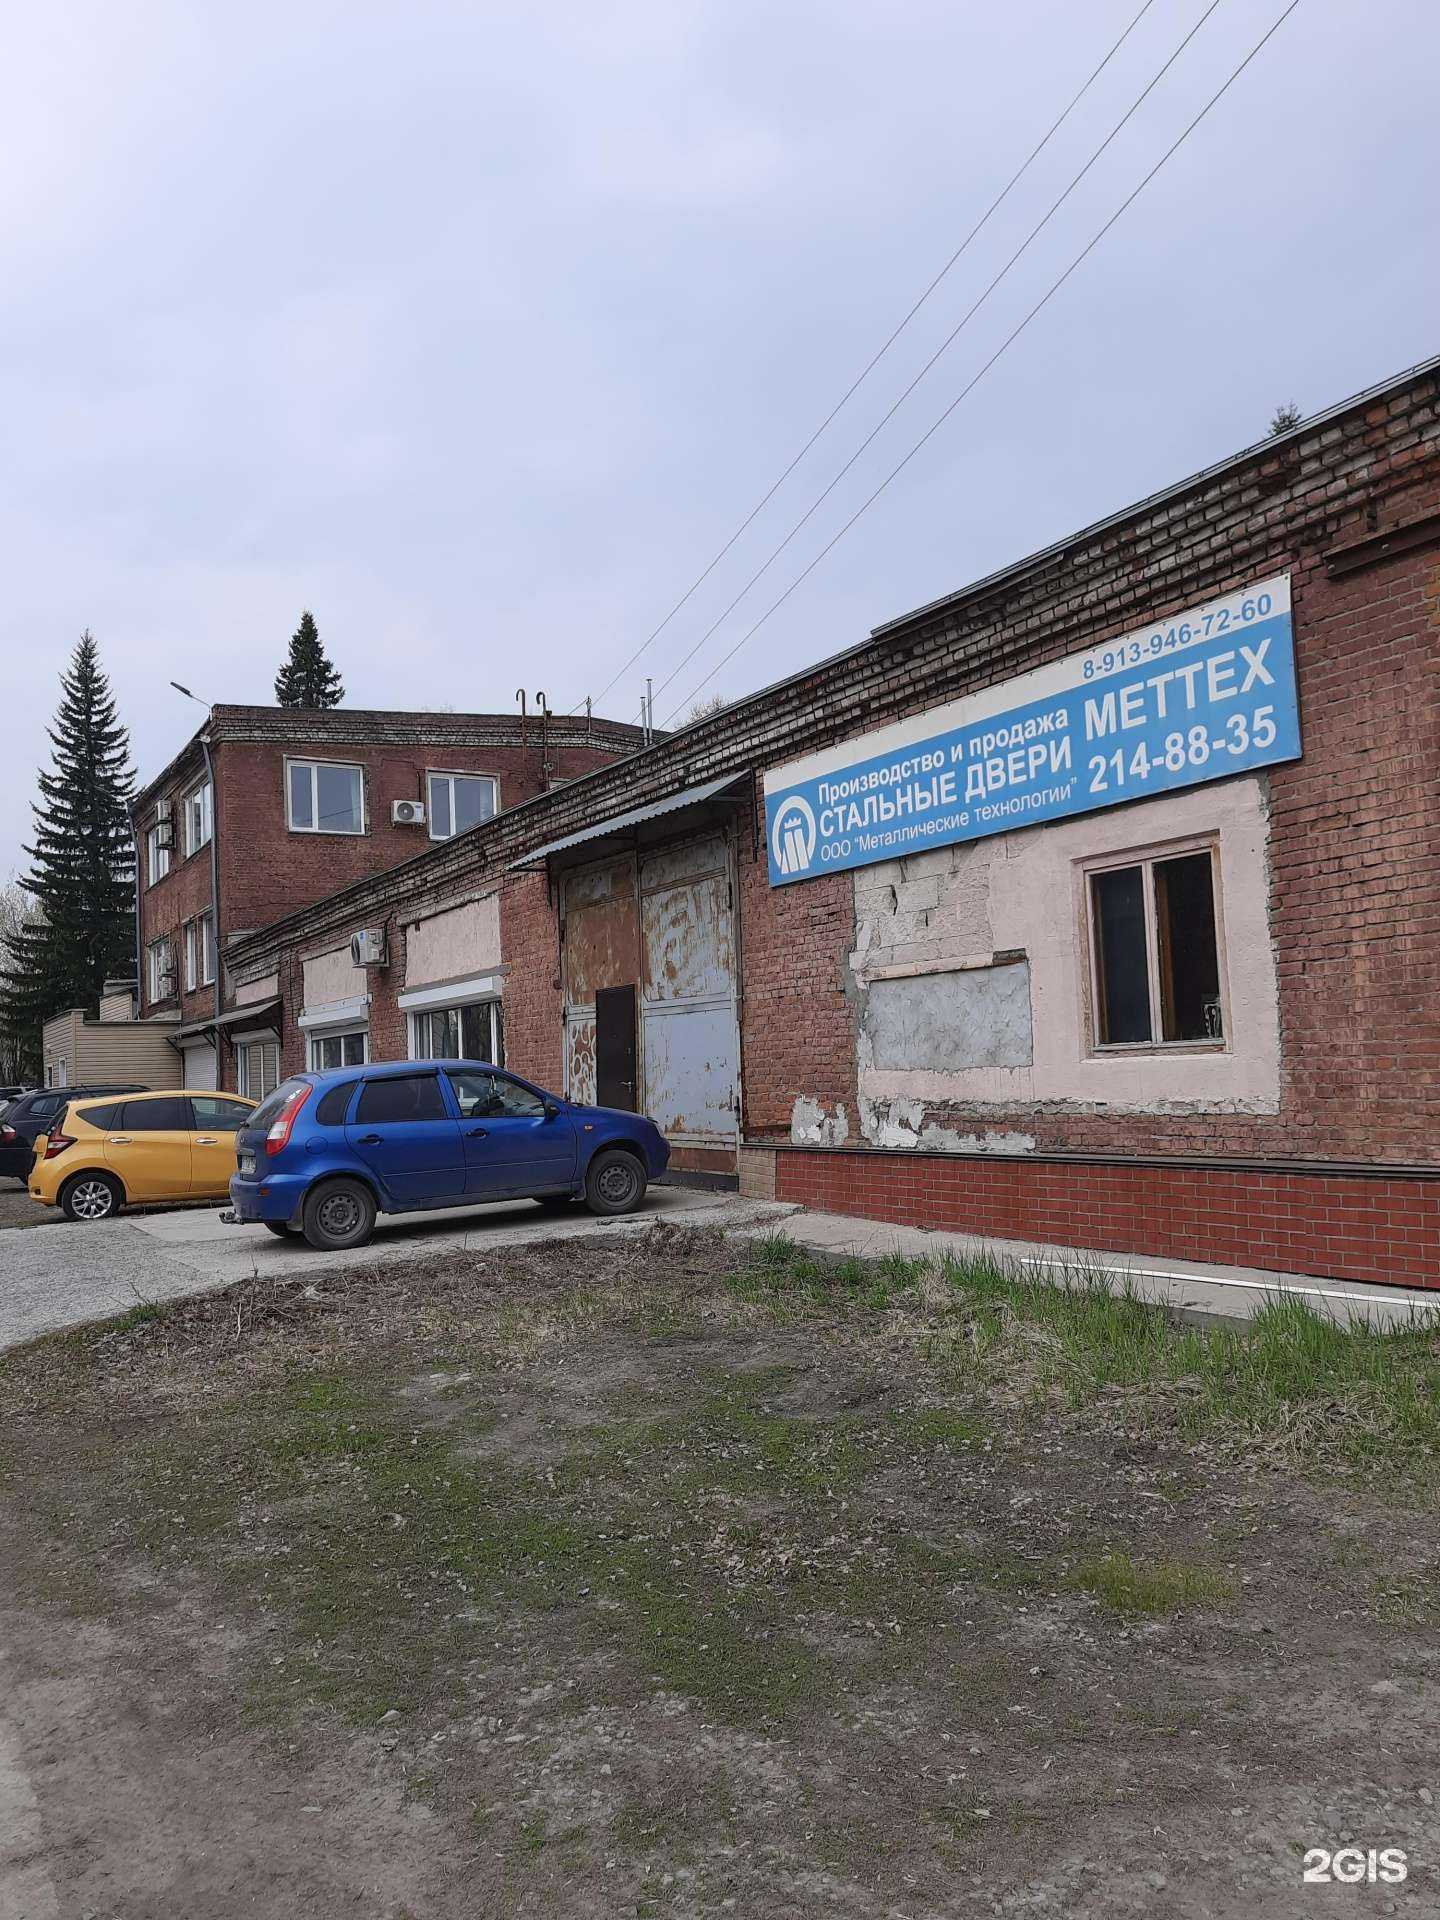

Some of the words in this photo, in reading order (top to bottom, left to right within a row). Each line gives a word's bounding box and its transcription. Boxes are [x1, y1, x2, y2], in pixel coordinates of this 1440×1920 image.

[1083, 594, 1272, 678] 8-913-946-72-60
[1085, 639, 1275, 740] МЕТТЕХ
[819, 749, 944, 804] Производство
[951, 743, 963, 760] и
[970, 709, 1067, 757] продажа
[820, 773, 957, 837] СТАЛЬНЫЕ
[965, 736, 1072, 803] ДВЕРИ
[1089, 705, 1276, 792] 214-88-35
[821, 841, 851, 861] ООО
